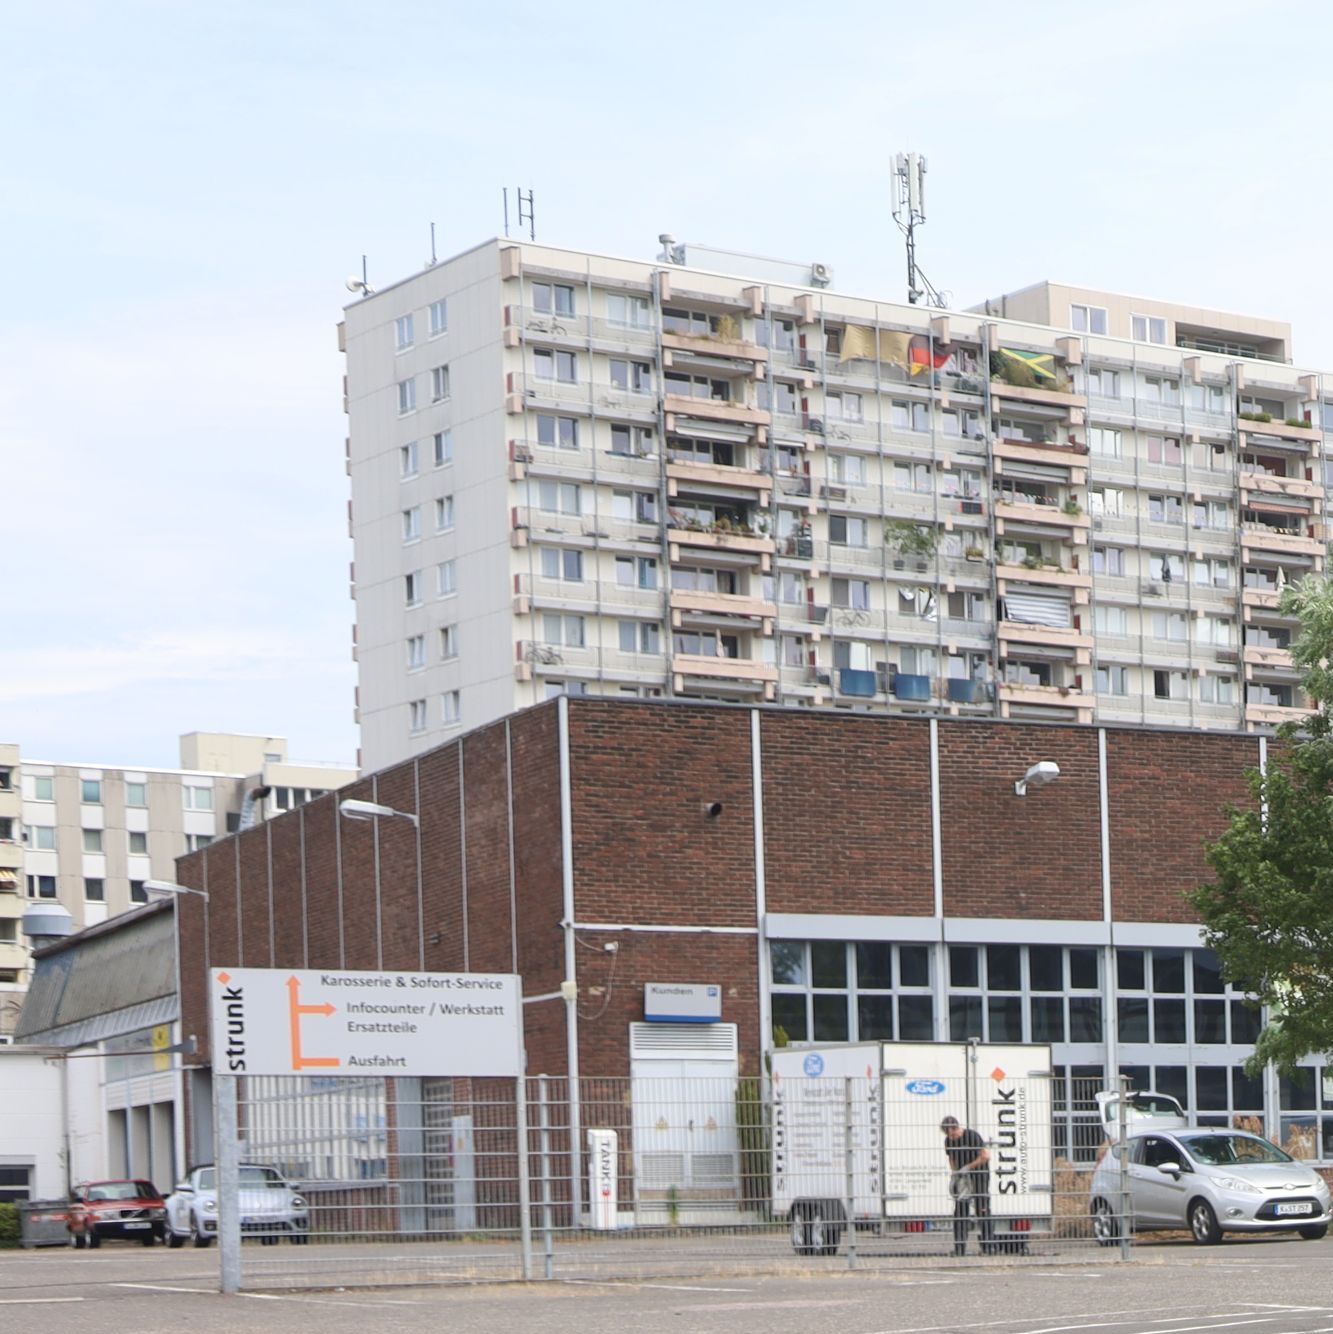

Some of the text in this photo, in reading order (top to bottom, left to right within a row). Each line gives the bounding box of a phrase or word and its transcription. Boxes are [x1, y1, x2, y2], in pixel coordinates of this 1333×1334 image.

[321, 975, 503, 990] Karosserie & Sofort-Service
[347, 1002, 505, 1016] Infocounter / Werkstatt
[221, 987, 246, 1071] strunk
[347, 1021, 418, 1033] Ersatzteile
[348, 1055, 407, 1067] Ausfahrt
[911, 1080, 939, 1094] Ford
[991, 1088, 1017, 1195] strunk
[1018, 1087, 1028, 1194] www.auto-strunk.de
